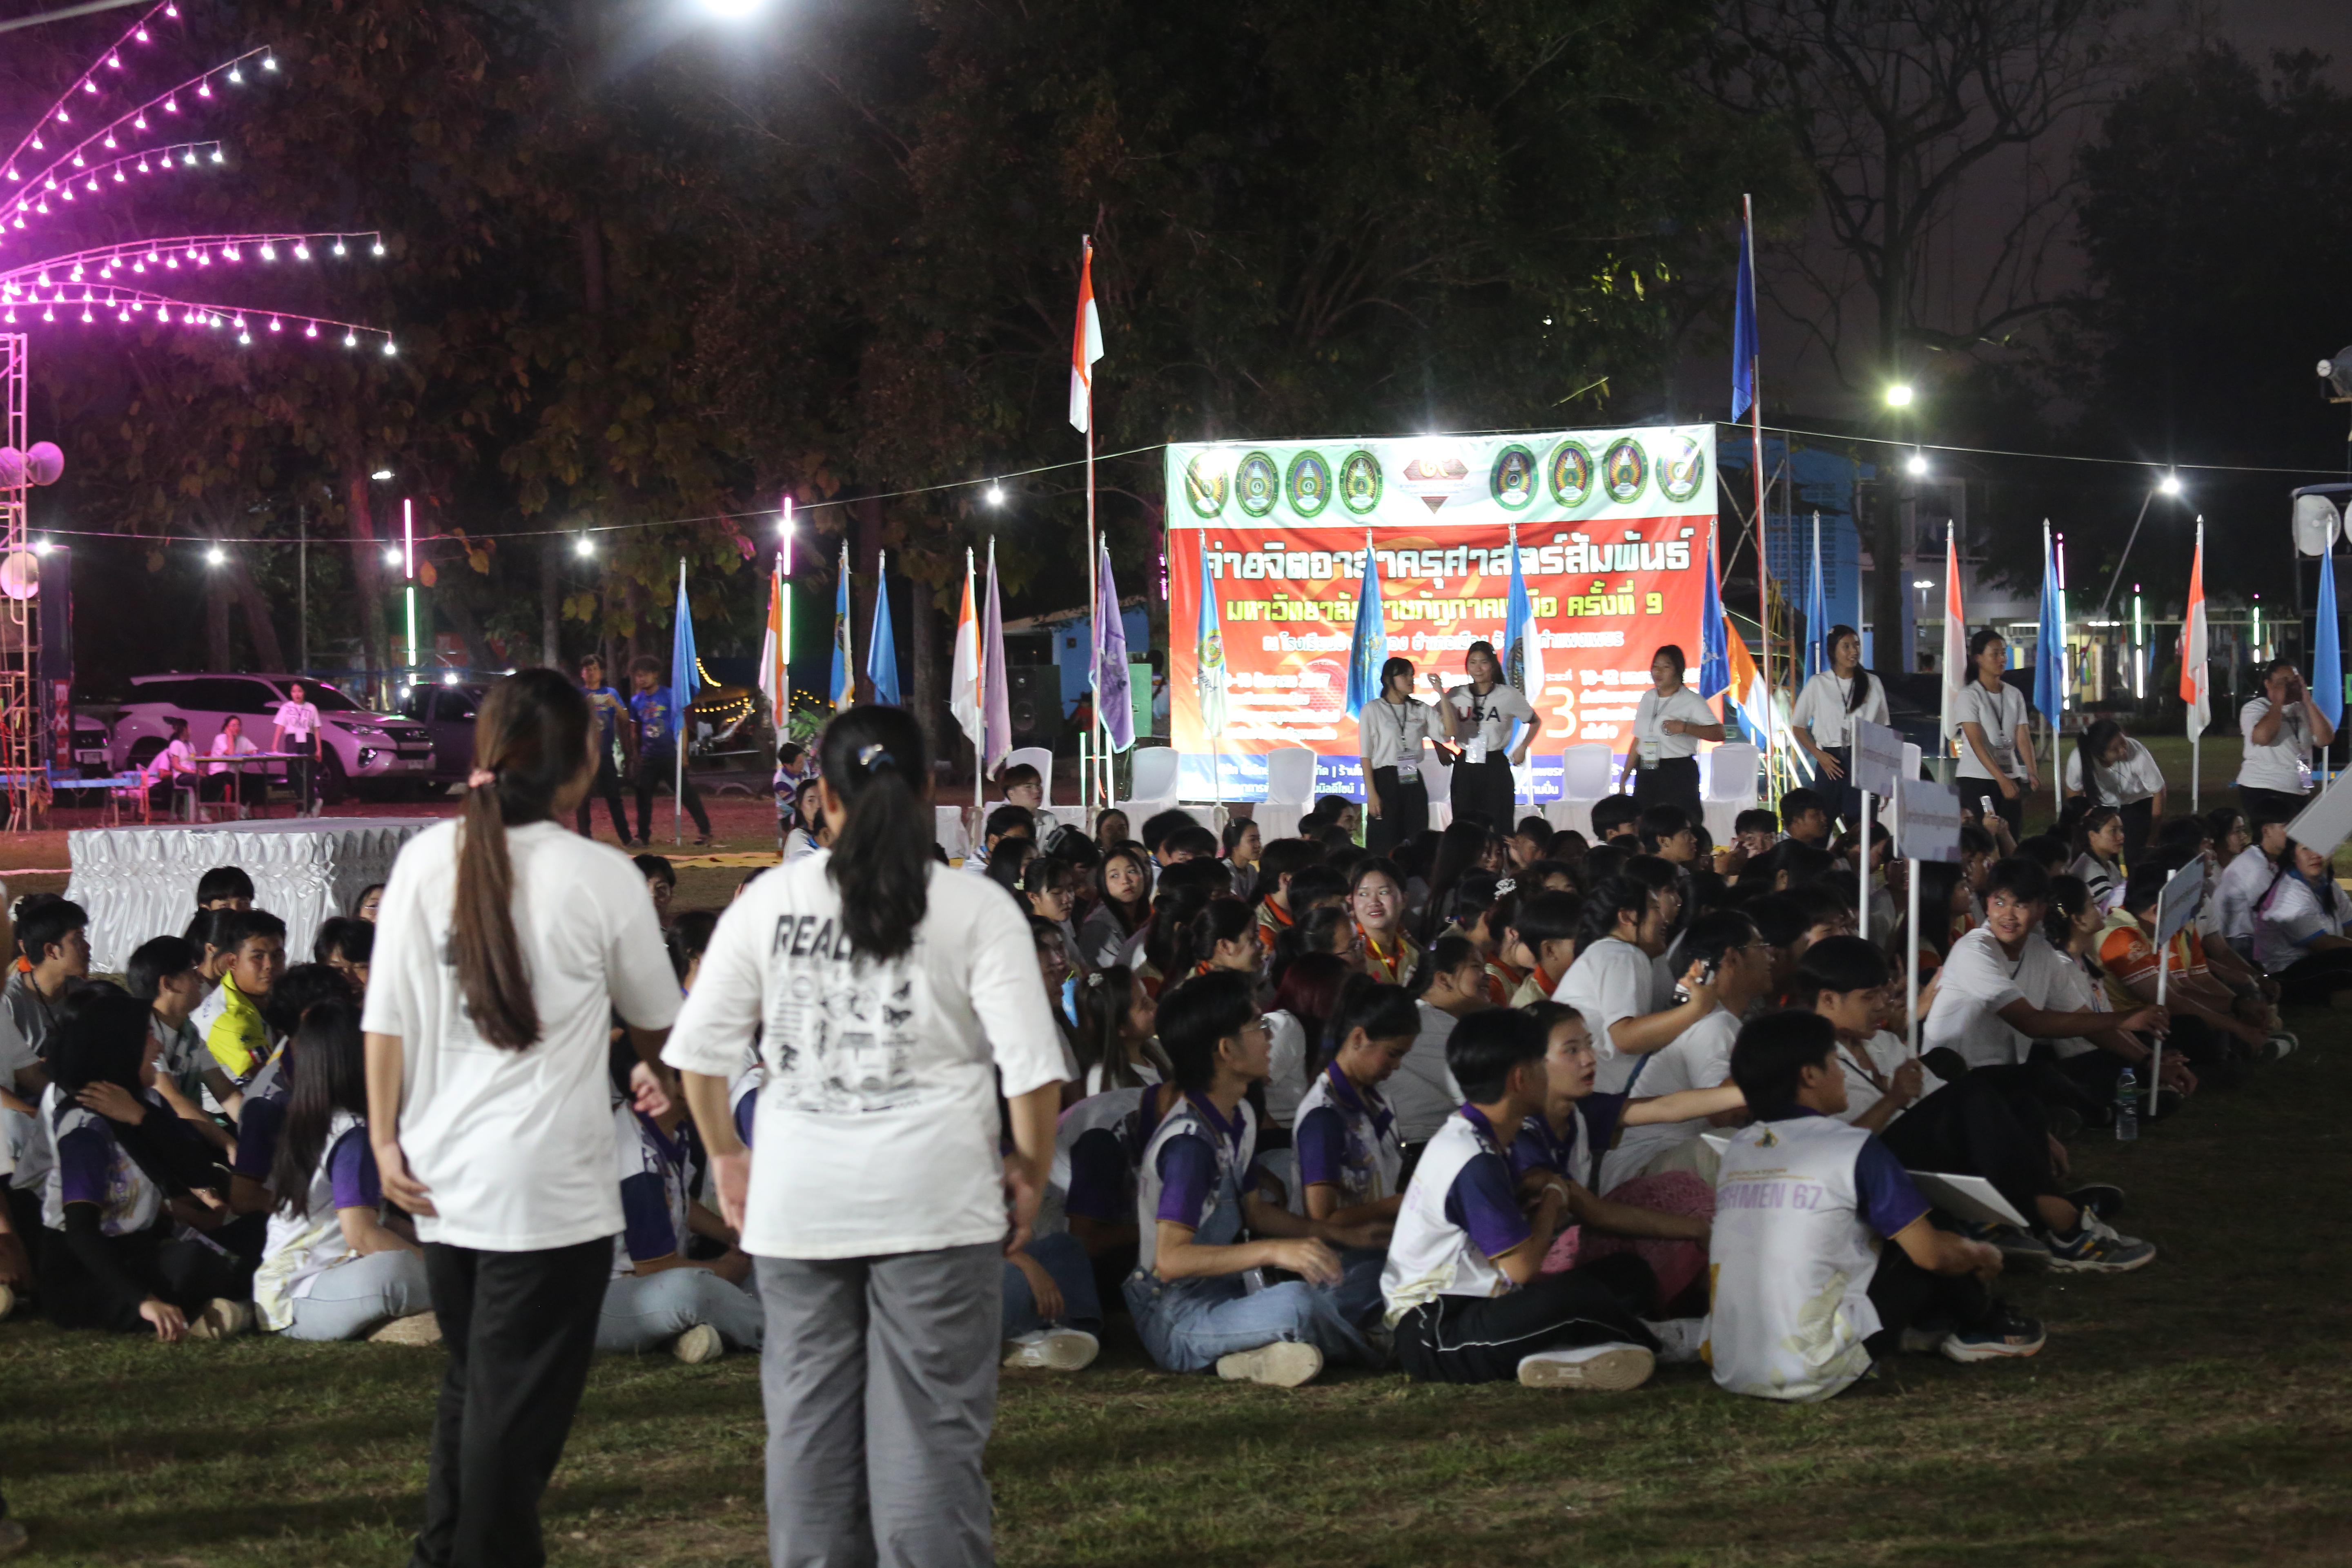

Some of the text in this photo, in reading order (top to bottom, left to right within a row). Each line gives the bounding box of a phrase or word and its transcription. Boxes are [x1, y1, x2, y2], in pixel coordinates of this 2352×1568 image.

[1567, 579, 1635, 617] ครั้งที่
[1646, 592, 1662, 614] 9
[1457, 706, 1501, 722] USA
[1545, 686, 1577, 738] 3
[1792, 1184, 1823, 1210] 67
